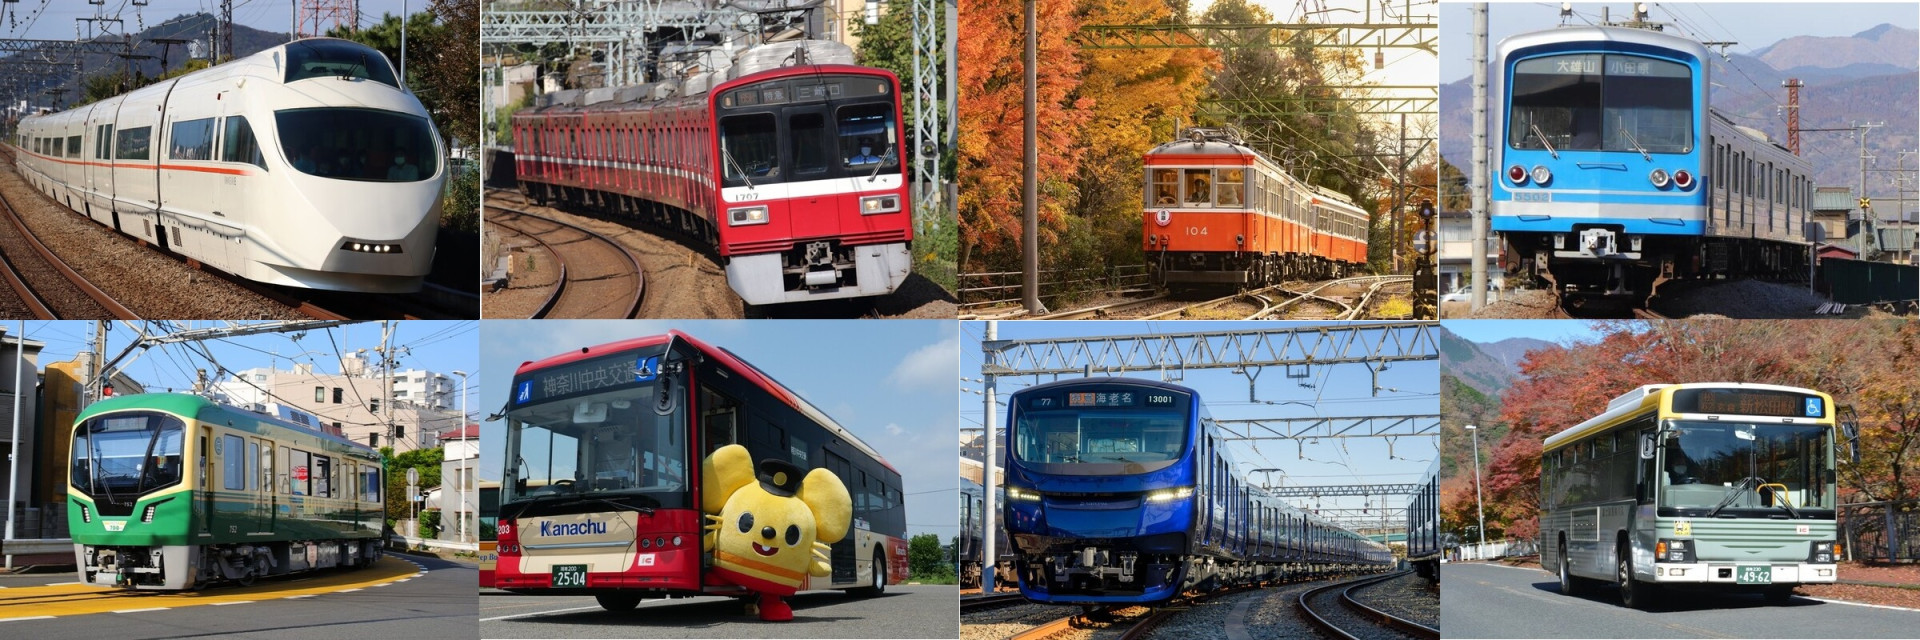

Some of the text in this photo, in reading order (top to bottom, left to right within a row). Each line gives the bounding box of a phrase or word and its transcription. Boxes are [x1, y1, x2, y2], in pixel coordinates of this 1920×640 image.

[1611, 62, 1649, 75] 小田原
[736, 193, 758, 201] 1707
[1186, 227, 1208, 235] 104
[543, 360, 637, 398] 神奈川中央交通
[1041, 398, 1051, 406] 77
[1096, 392, 1132, 403] 海老名
[1148, 395, 1172, 403] 13001
[541, 519, 606, 536] Kanachu
